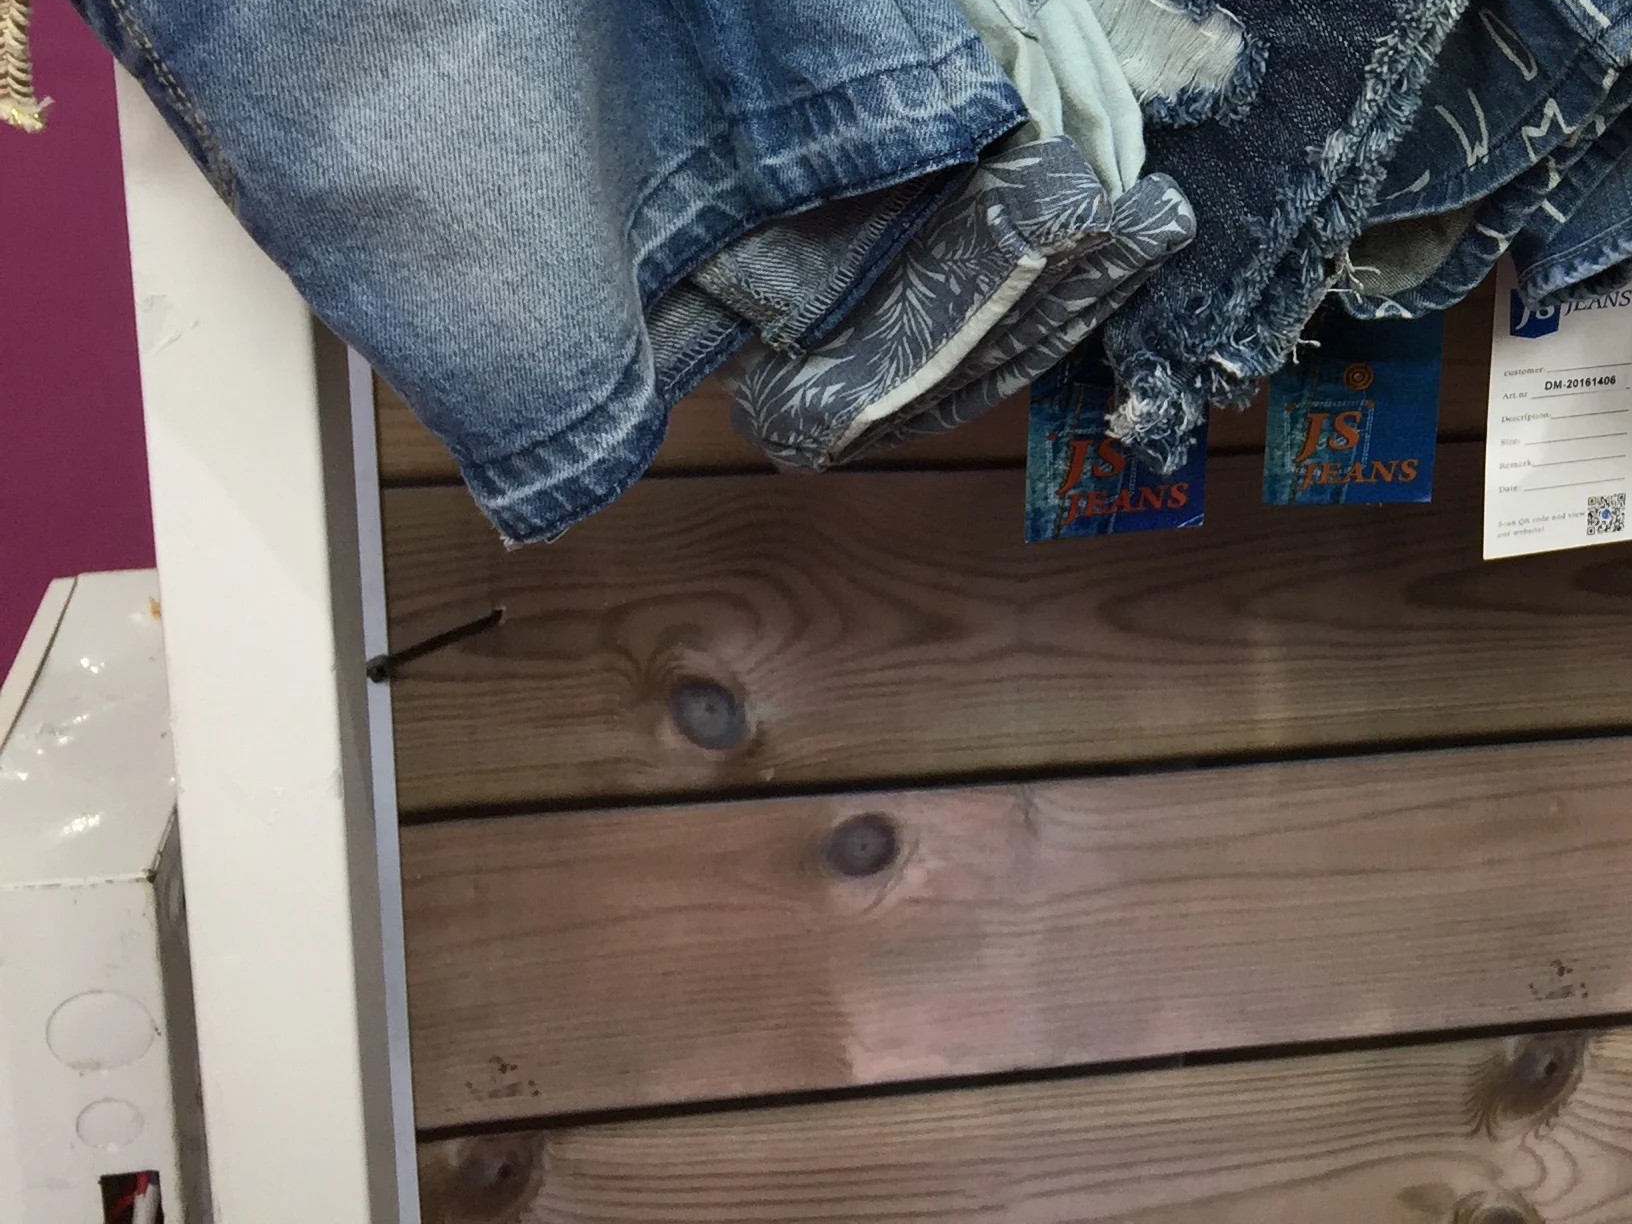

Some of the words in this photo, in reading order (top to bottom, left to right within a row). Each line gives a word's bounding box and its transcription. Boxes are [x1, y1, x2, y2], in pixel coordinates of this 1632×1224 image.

[1544, 375, 1616, 391] DM-20161406
[1294, 410, 1362, 465] JS
[1056, 438, 1127, 495] JS
[1298, 458, 1419, 492] JEANS
[1063, 482, 1190, 527] JEANS
